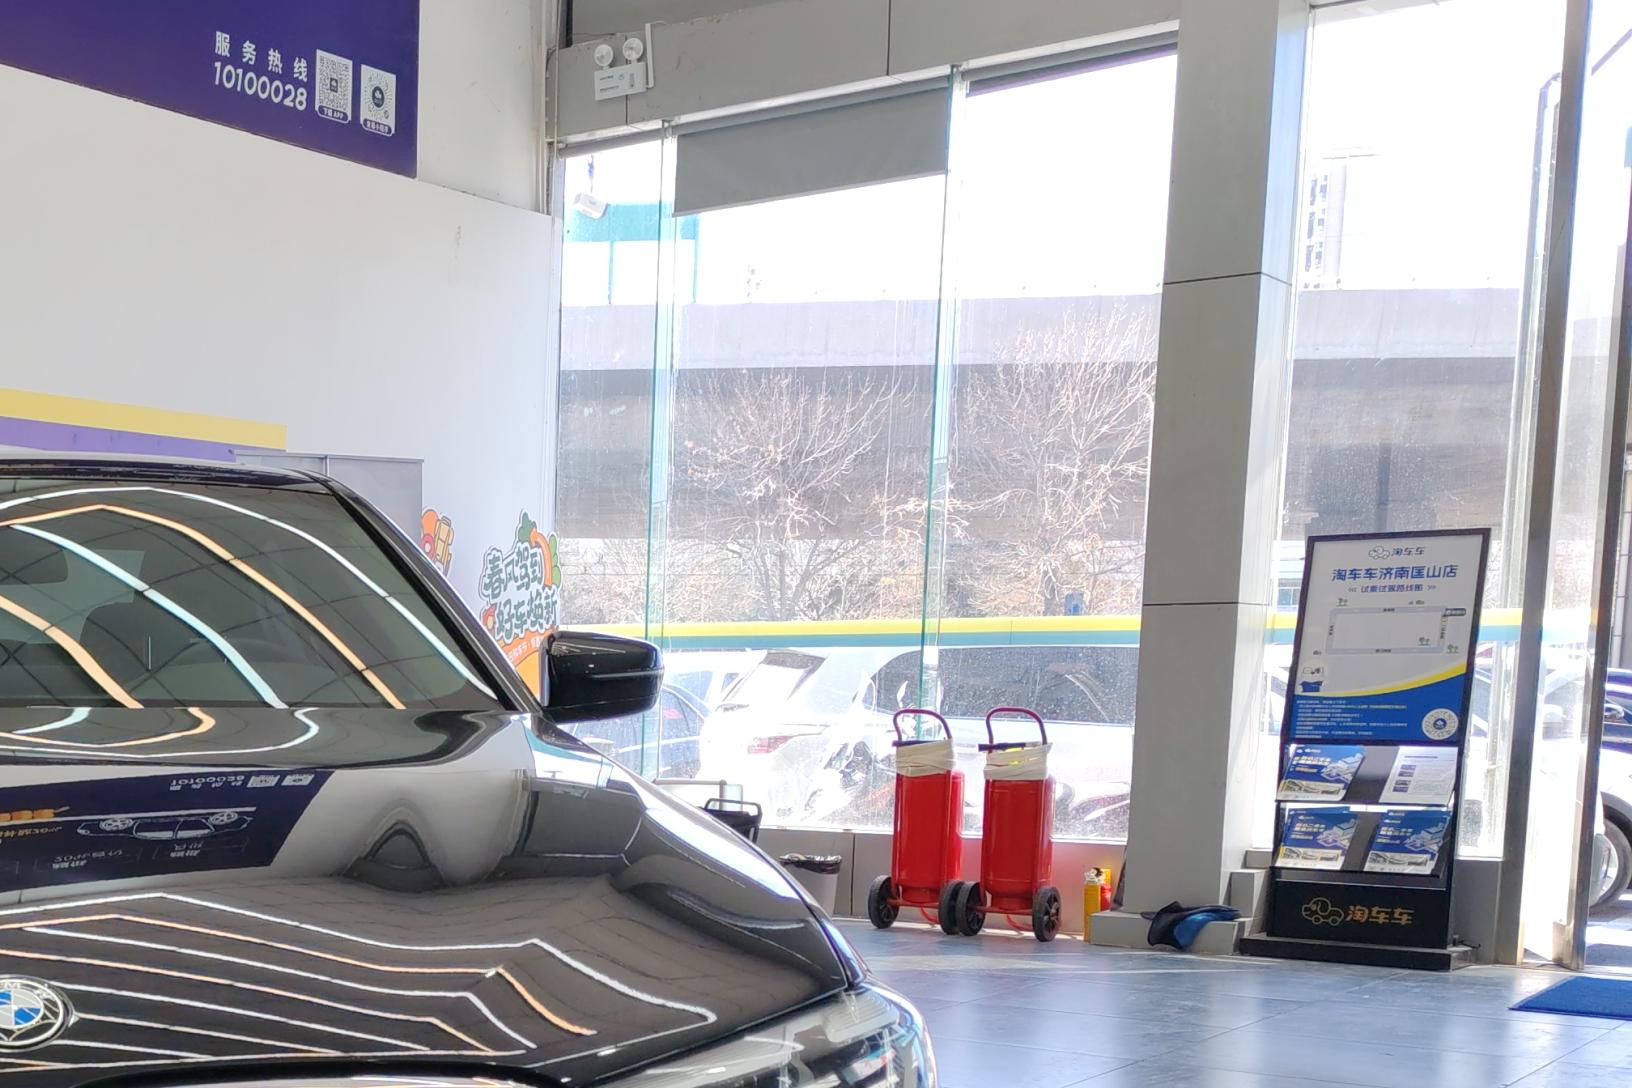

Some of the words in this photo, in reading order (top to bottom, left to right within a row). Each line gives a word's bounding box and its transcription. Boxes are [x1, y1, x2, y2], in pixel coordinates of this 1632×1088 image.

[215, 31, 308, 82] 服务热线
[214, 61, 308, 111] 10100028
[1391, 547, 1424, 558] 淘车车
[484, 546, 543, 600] 春风驾到
[1331, 565, 1458, 582] 淘车车济南匡山店
[1346, 906, 1415, 925] 淘车车
